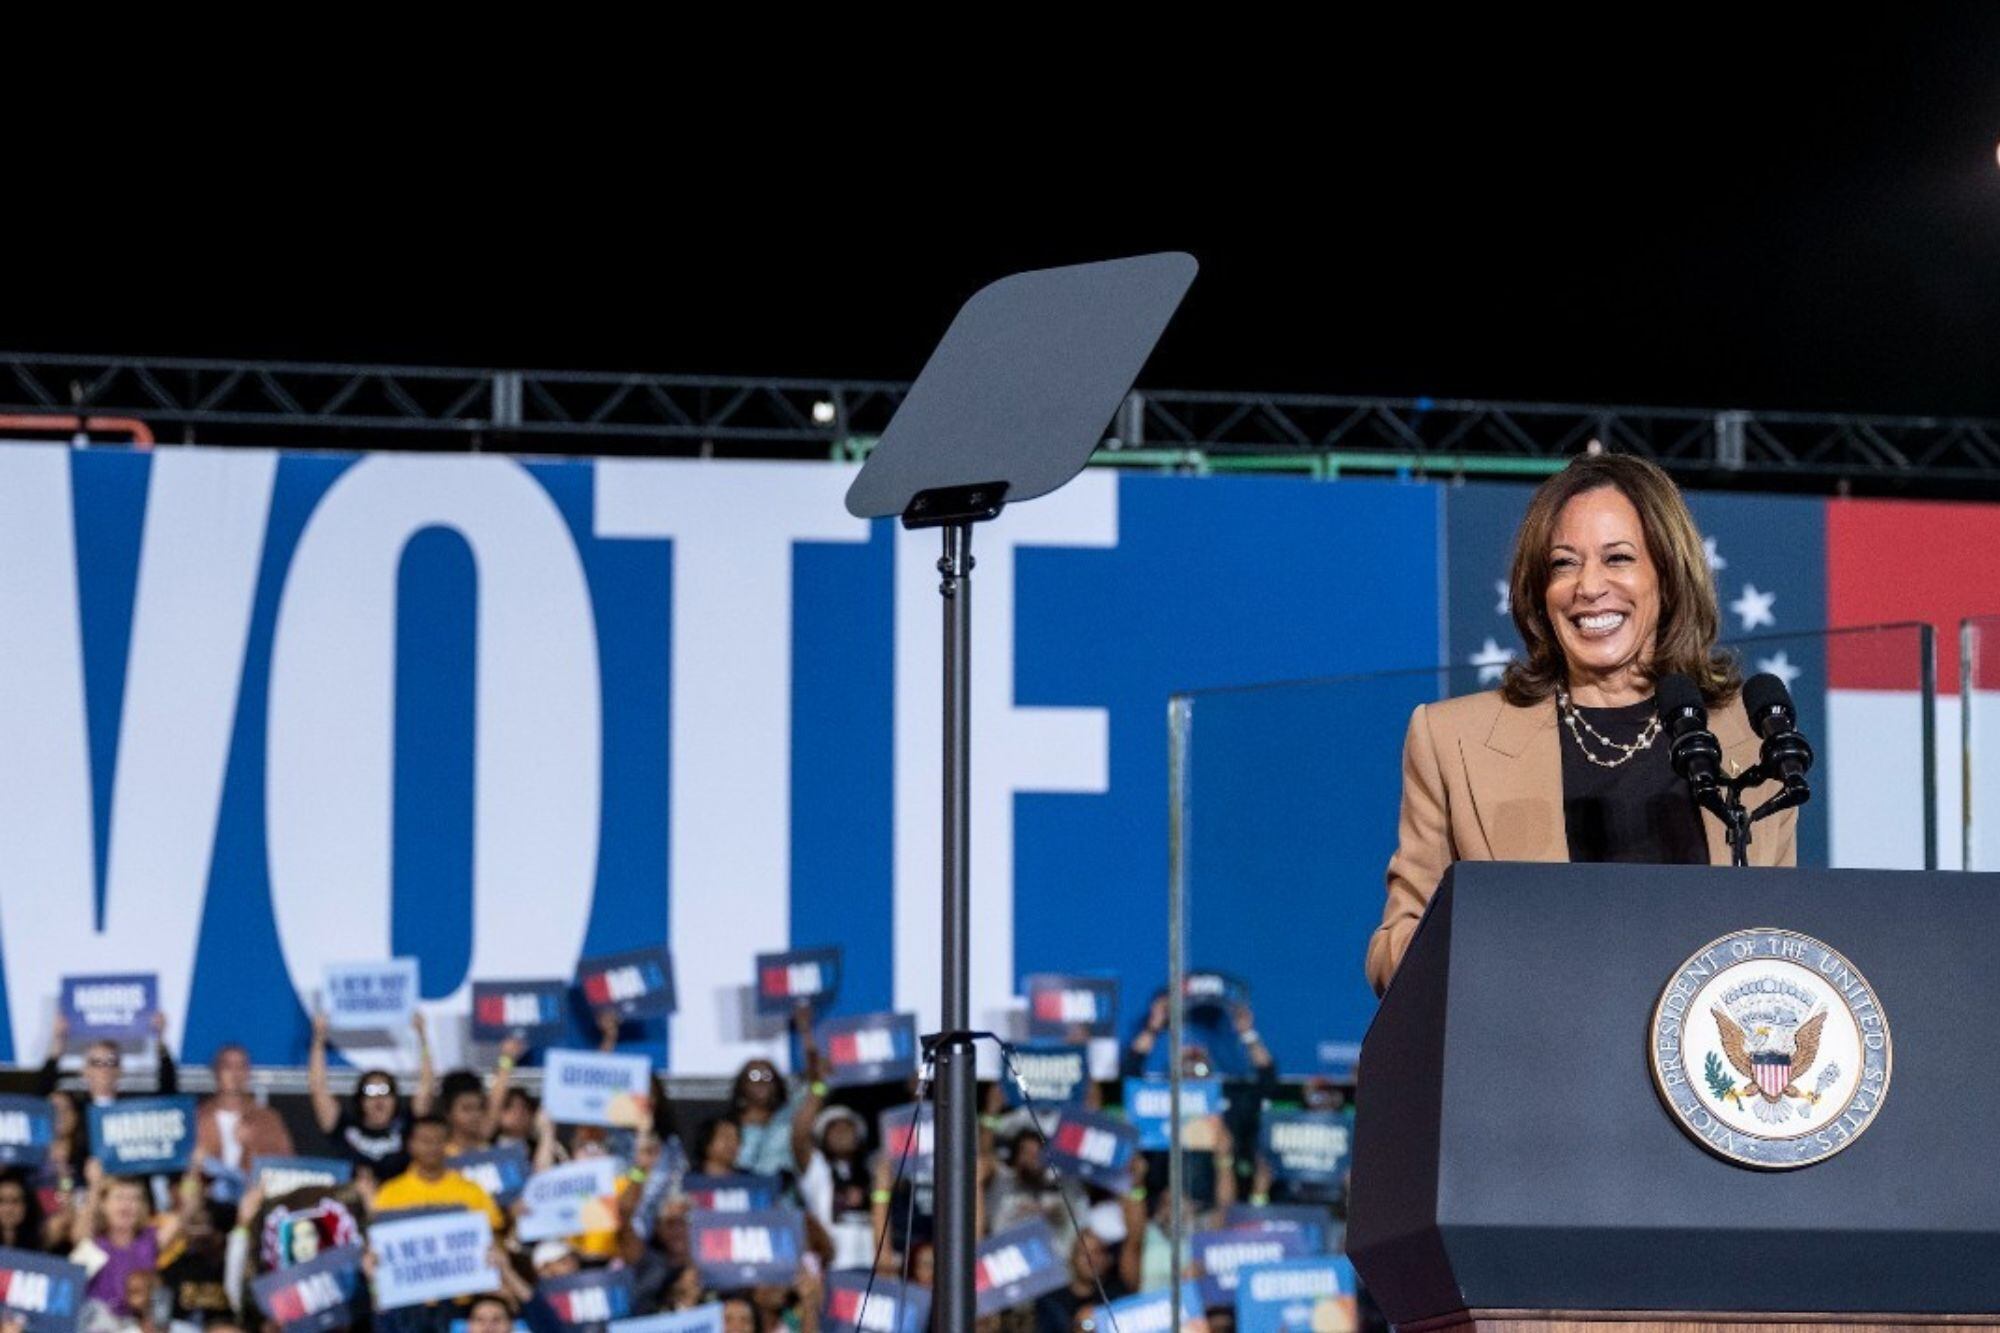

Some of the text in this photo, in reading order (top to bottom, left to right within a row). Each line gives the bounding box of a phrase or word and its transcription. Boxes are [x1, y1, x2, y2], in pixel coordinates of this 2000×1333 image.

[0, 443, 1119, 1078] VOTE
[1731, 940, 1757, 960] OF
[1768, 938, 1808, 960] THE
[1659, 952, 1718, 1086] PRESIDENT
[1819, 951, 1884, 1050] UNITED
[1679, 1101, 1734, 1151] VICE
[1815, 1067, 1884, 1151] STATES
